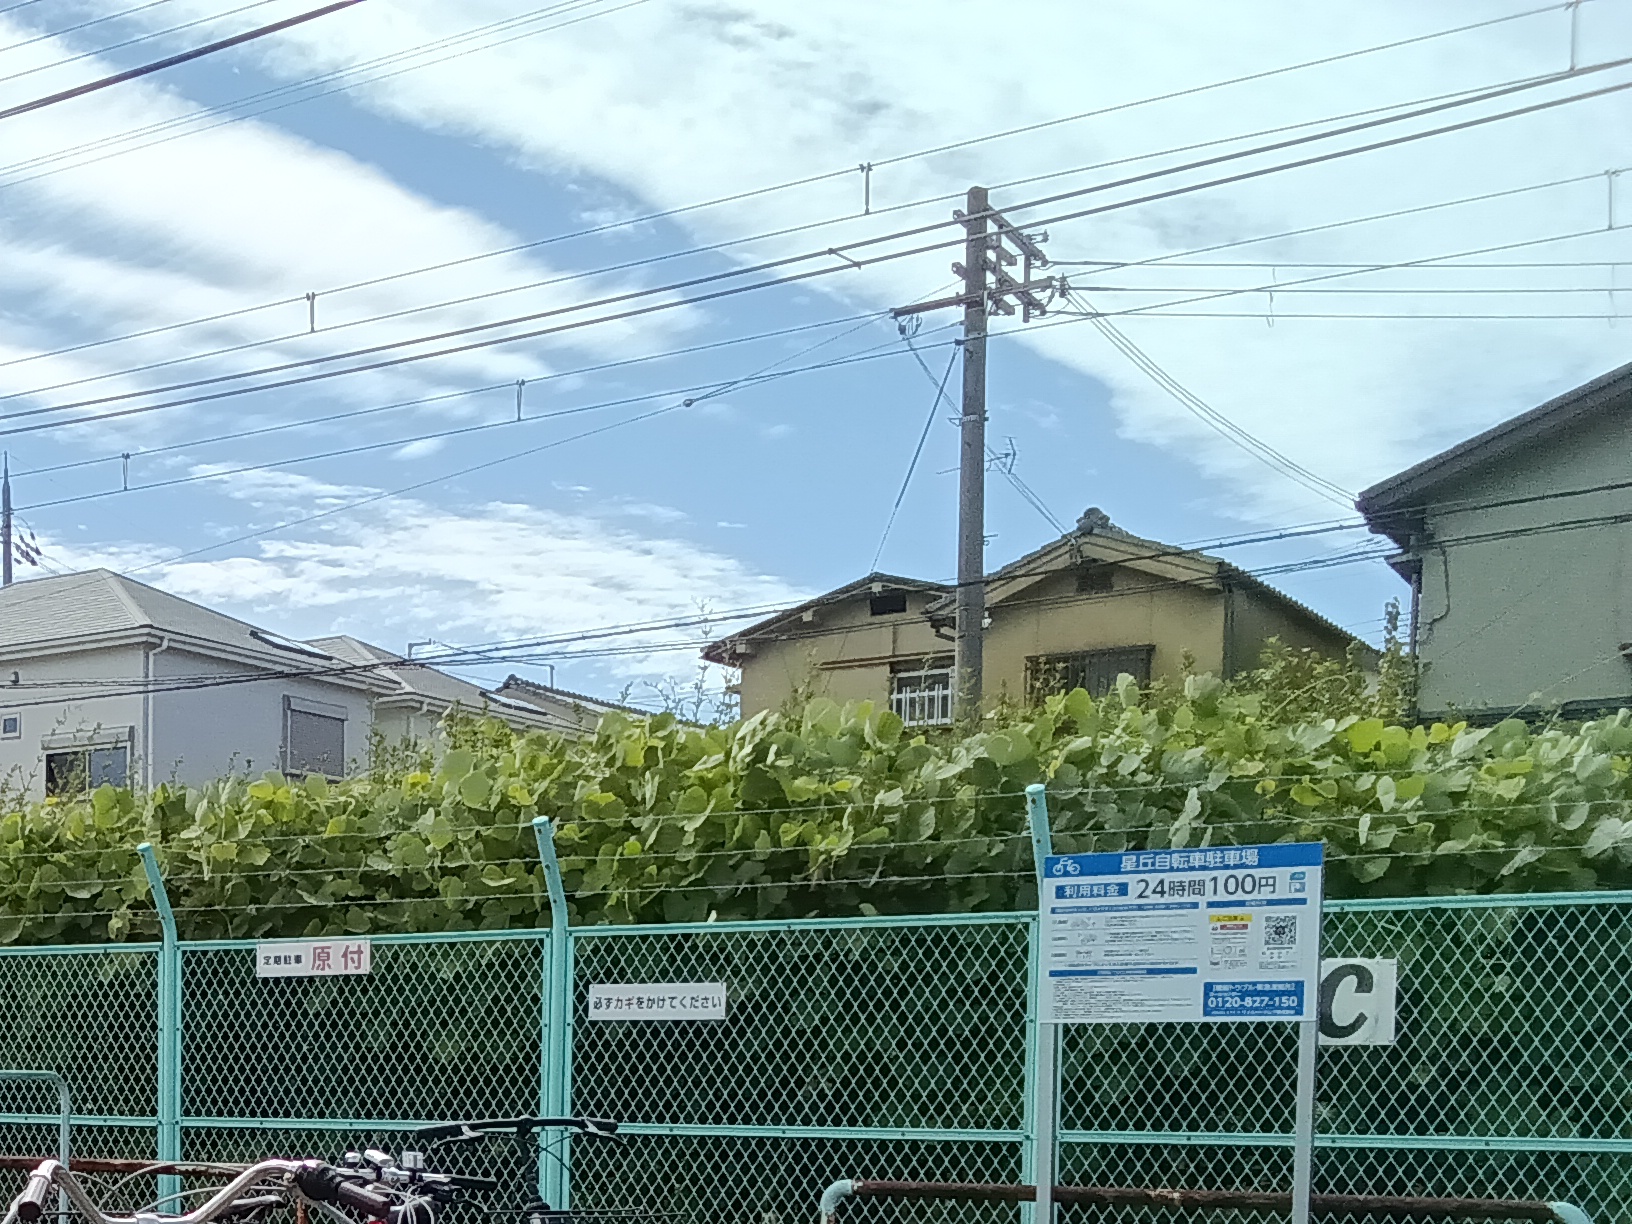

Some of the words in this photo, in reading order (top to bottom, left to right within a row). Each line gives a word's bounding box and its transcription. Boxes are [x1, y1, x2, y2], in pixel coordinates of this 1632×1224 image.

[1120, 848, 1260, 872] 星丘自転車駐車場
[1064, 884, 1121, 898] 利用料金
[1134, 873, 1277, 899] 24時間100円
[593, 994, 723, 1010] 必ずカギをかけてください
[1207, 996, 1299, 1009] 0120-827-150
[1320, 963, 1374, 1039] C
